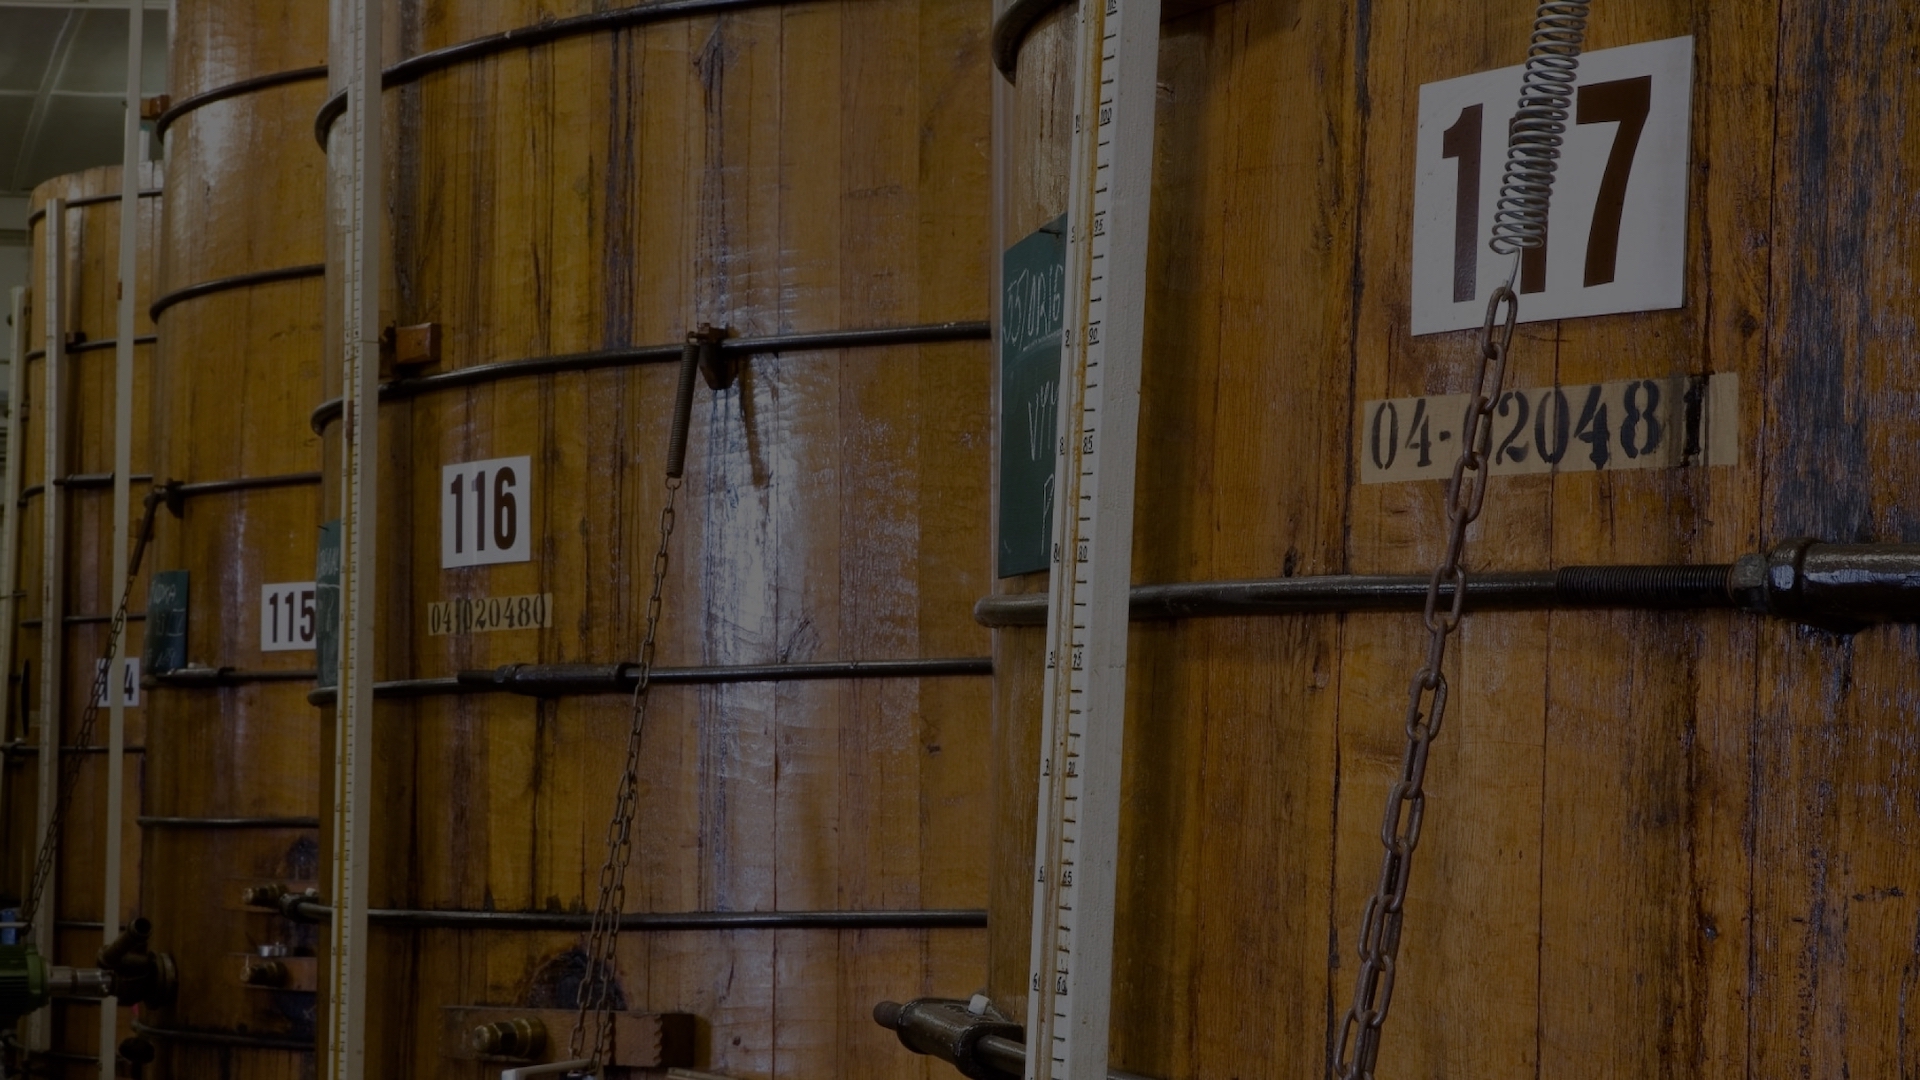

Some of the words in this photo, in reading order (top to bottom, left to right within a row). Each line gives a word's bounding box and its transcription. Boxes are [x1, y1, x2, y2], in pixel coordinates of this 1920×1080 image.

[1094, 219, 1104, 232] 95
[1088, 327, 1098, 341] 90
[1371, 375, 1707, 469] 04-20481
[450, 466, 517, 554] 116
[269, 590, 315, 643] 115
